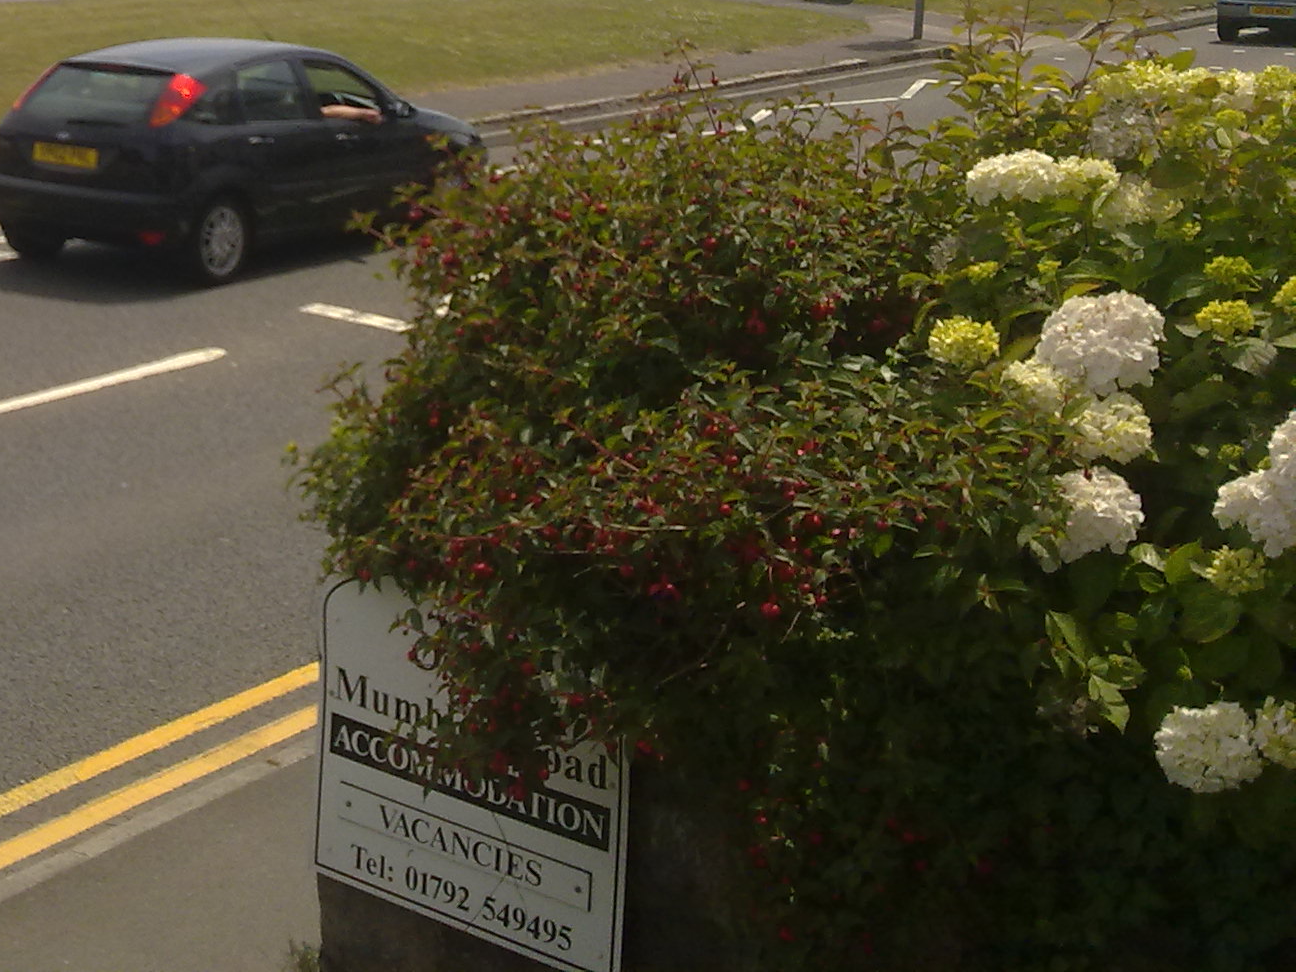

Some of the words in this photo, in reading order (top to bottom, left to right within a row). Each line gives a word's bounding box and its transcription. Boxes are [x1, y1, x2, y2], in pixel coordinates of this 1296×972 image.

[379, 804, 543, 887] VACANCIES
[351, 843, 394, 882] Tel:
[404, 864, 471, 912] 01792
[481, 897, 574, 952] 549495
